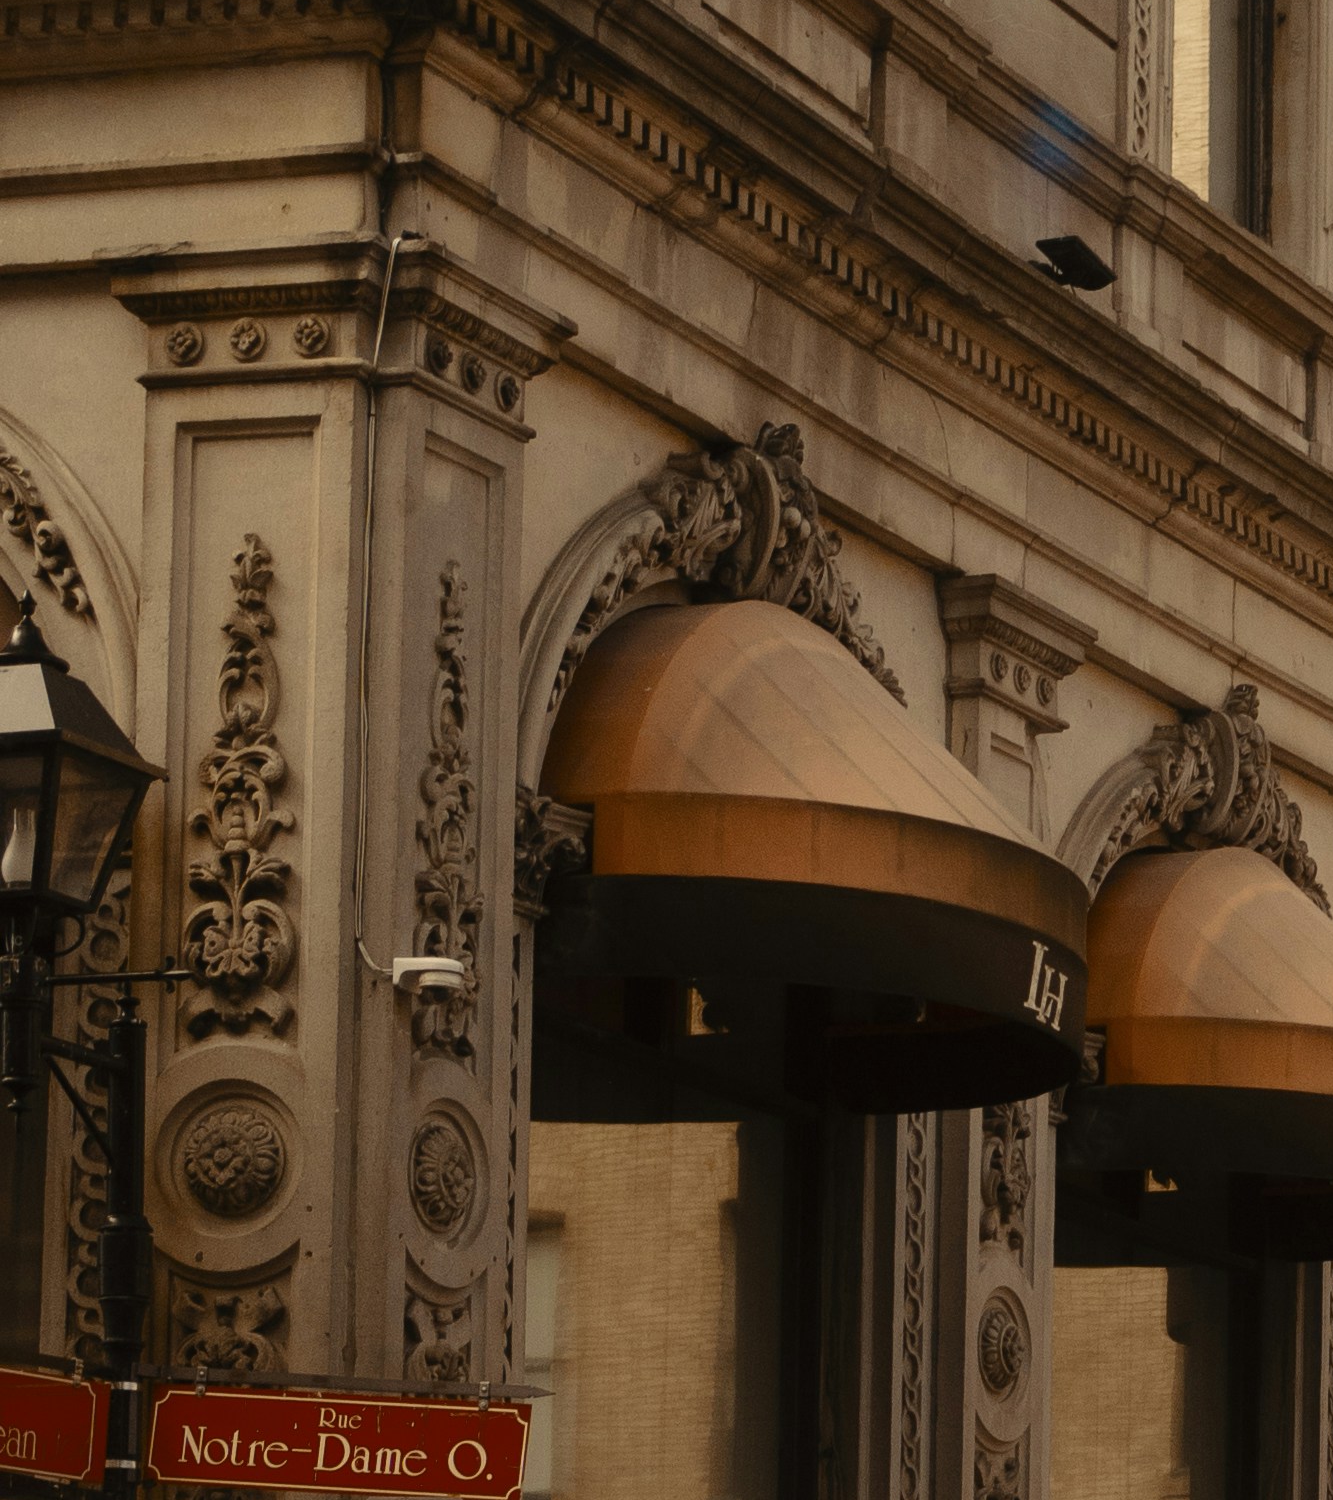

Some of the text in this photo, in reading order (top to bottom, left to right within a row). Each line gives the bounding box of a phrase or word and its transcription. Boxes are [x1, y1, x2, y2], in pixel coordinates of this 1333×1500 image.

[318, 1407, 362, 1430] Rue
[178, 1425, 493, 1481] Notre-Dame O.
